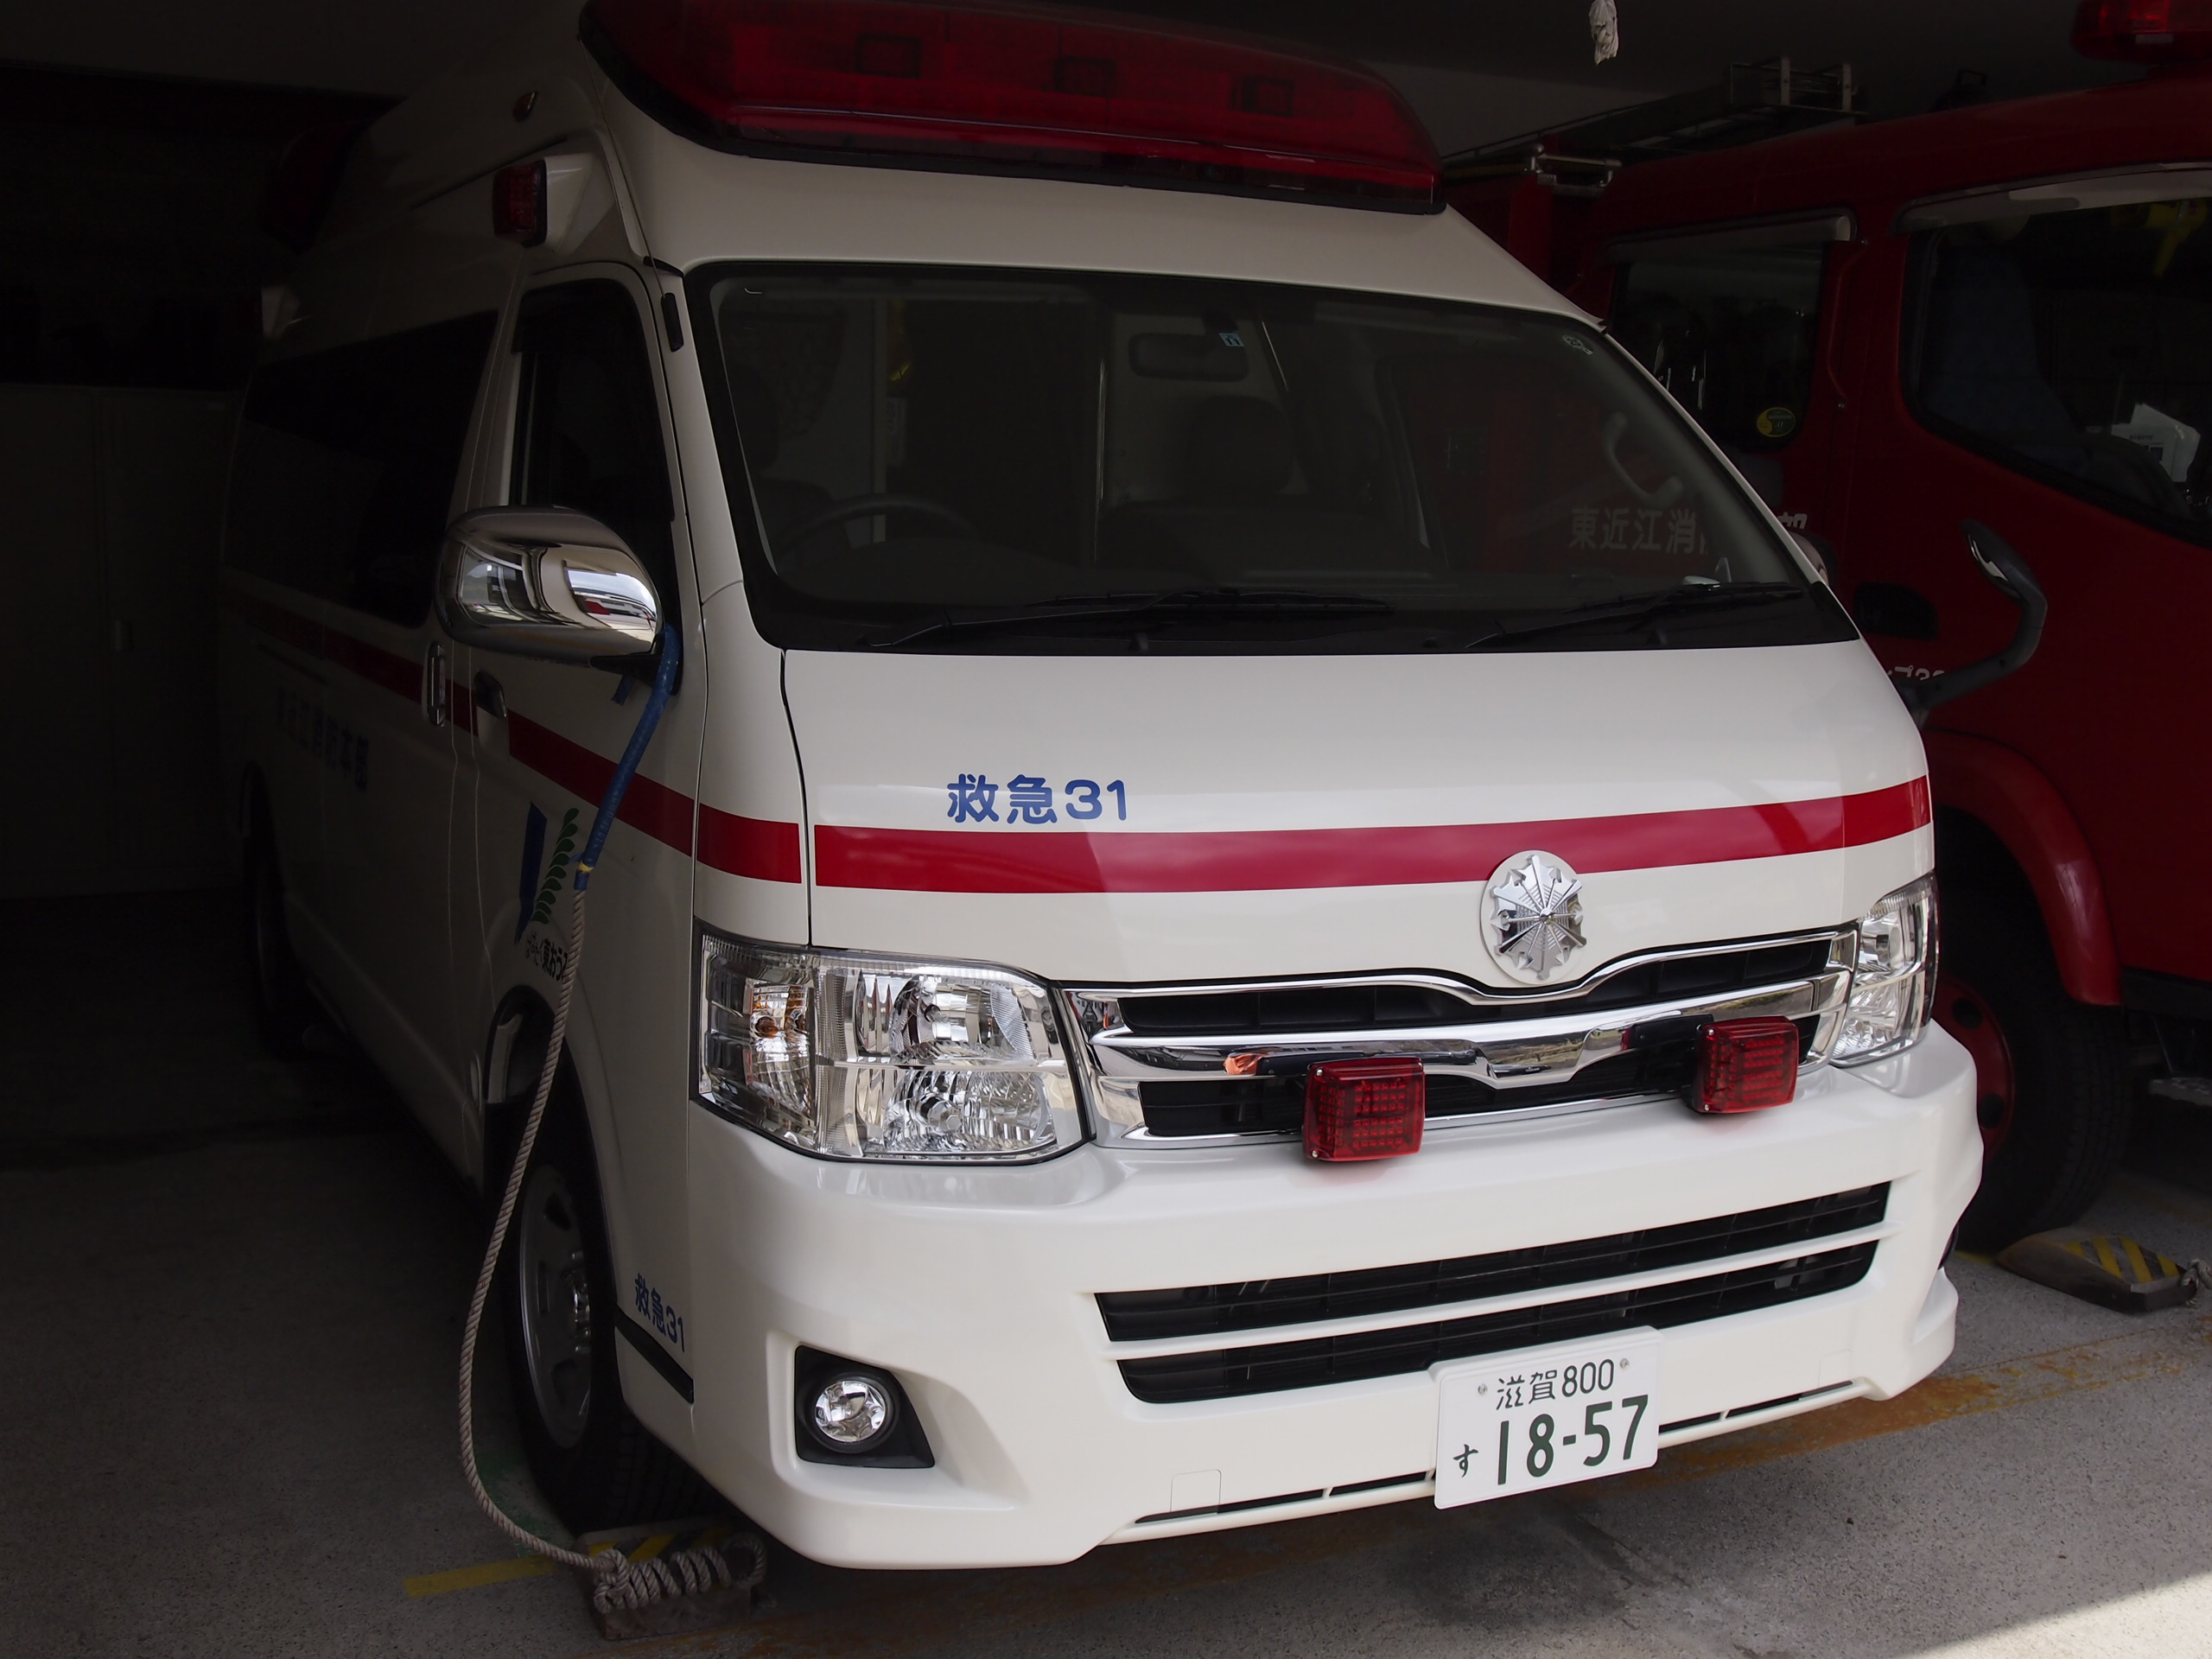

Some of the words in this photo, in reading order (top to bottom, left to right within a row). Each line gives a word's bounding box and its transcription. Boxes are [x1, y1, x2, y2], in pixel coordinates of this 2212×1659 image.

[947, 773, 1127, 824] 救急31
[635, 1273, 684, 1353] 救急31
[1497, 1359, 1614, 1410] 滋賀800
[1452, 1444, 1479, 1478] す
[1497, 1395, 1649, 1485] 18-57
